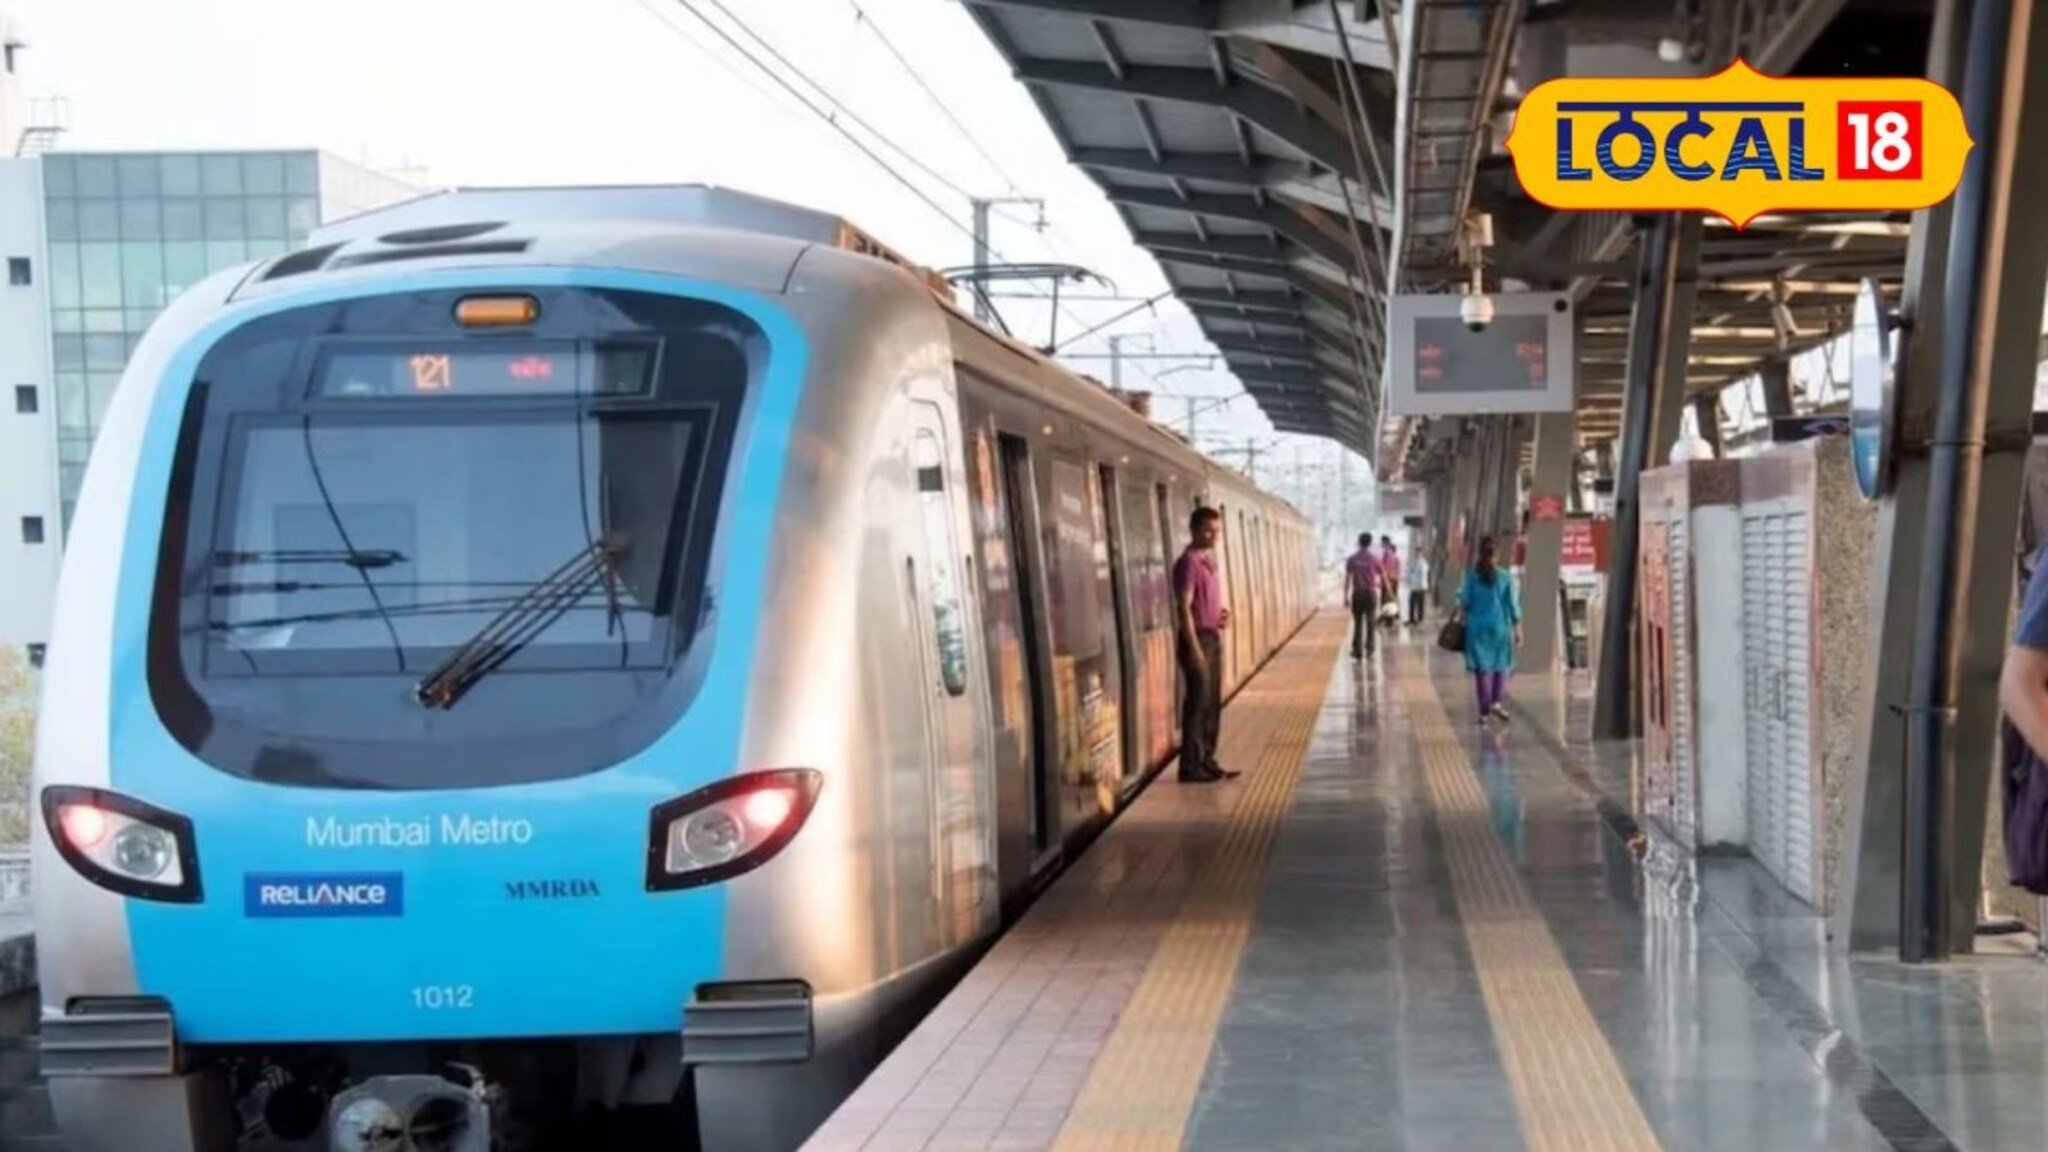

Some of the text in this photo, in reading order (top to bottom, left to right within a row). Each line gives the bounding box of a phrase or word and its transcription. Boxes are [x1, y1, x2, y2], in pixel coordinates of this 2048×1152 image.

[411, 354, 450, 389] 121
[306, 812, 533, 847] Mumbai Metro
[505, 880, 601, 901] MMRDA
[412, 986, 473, 1009] 1012
